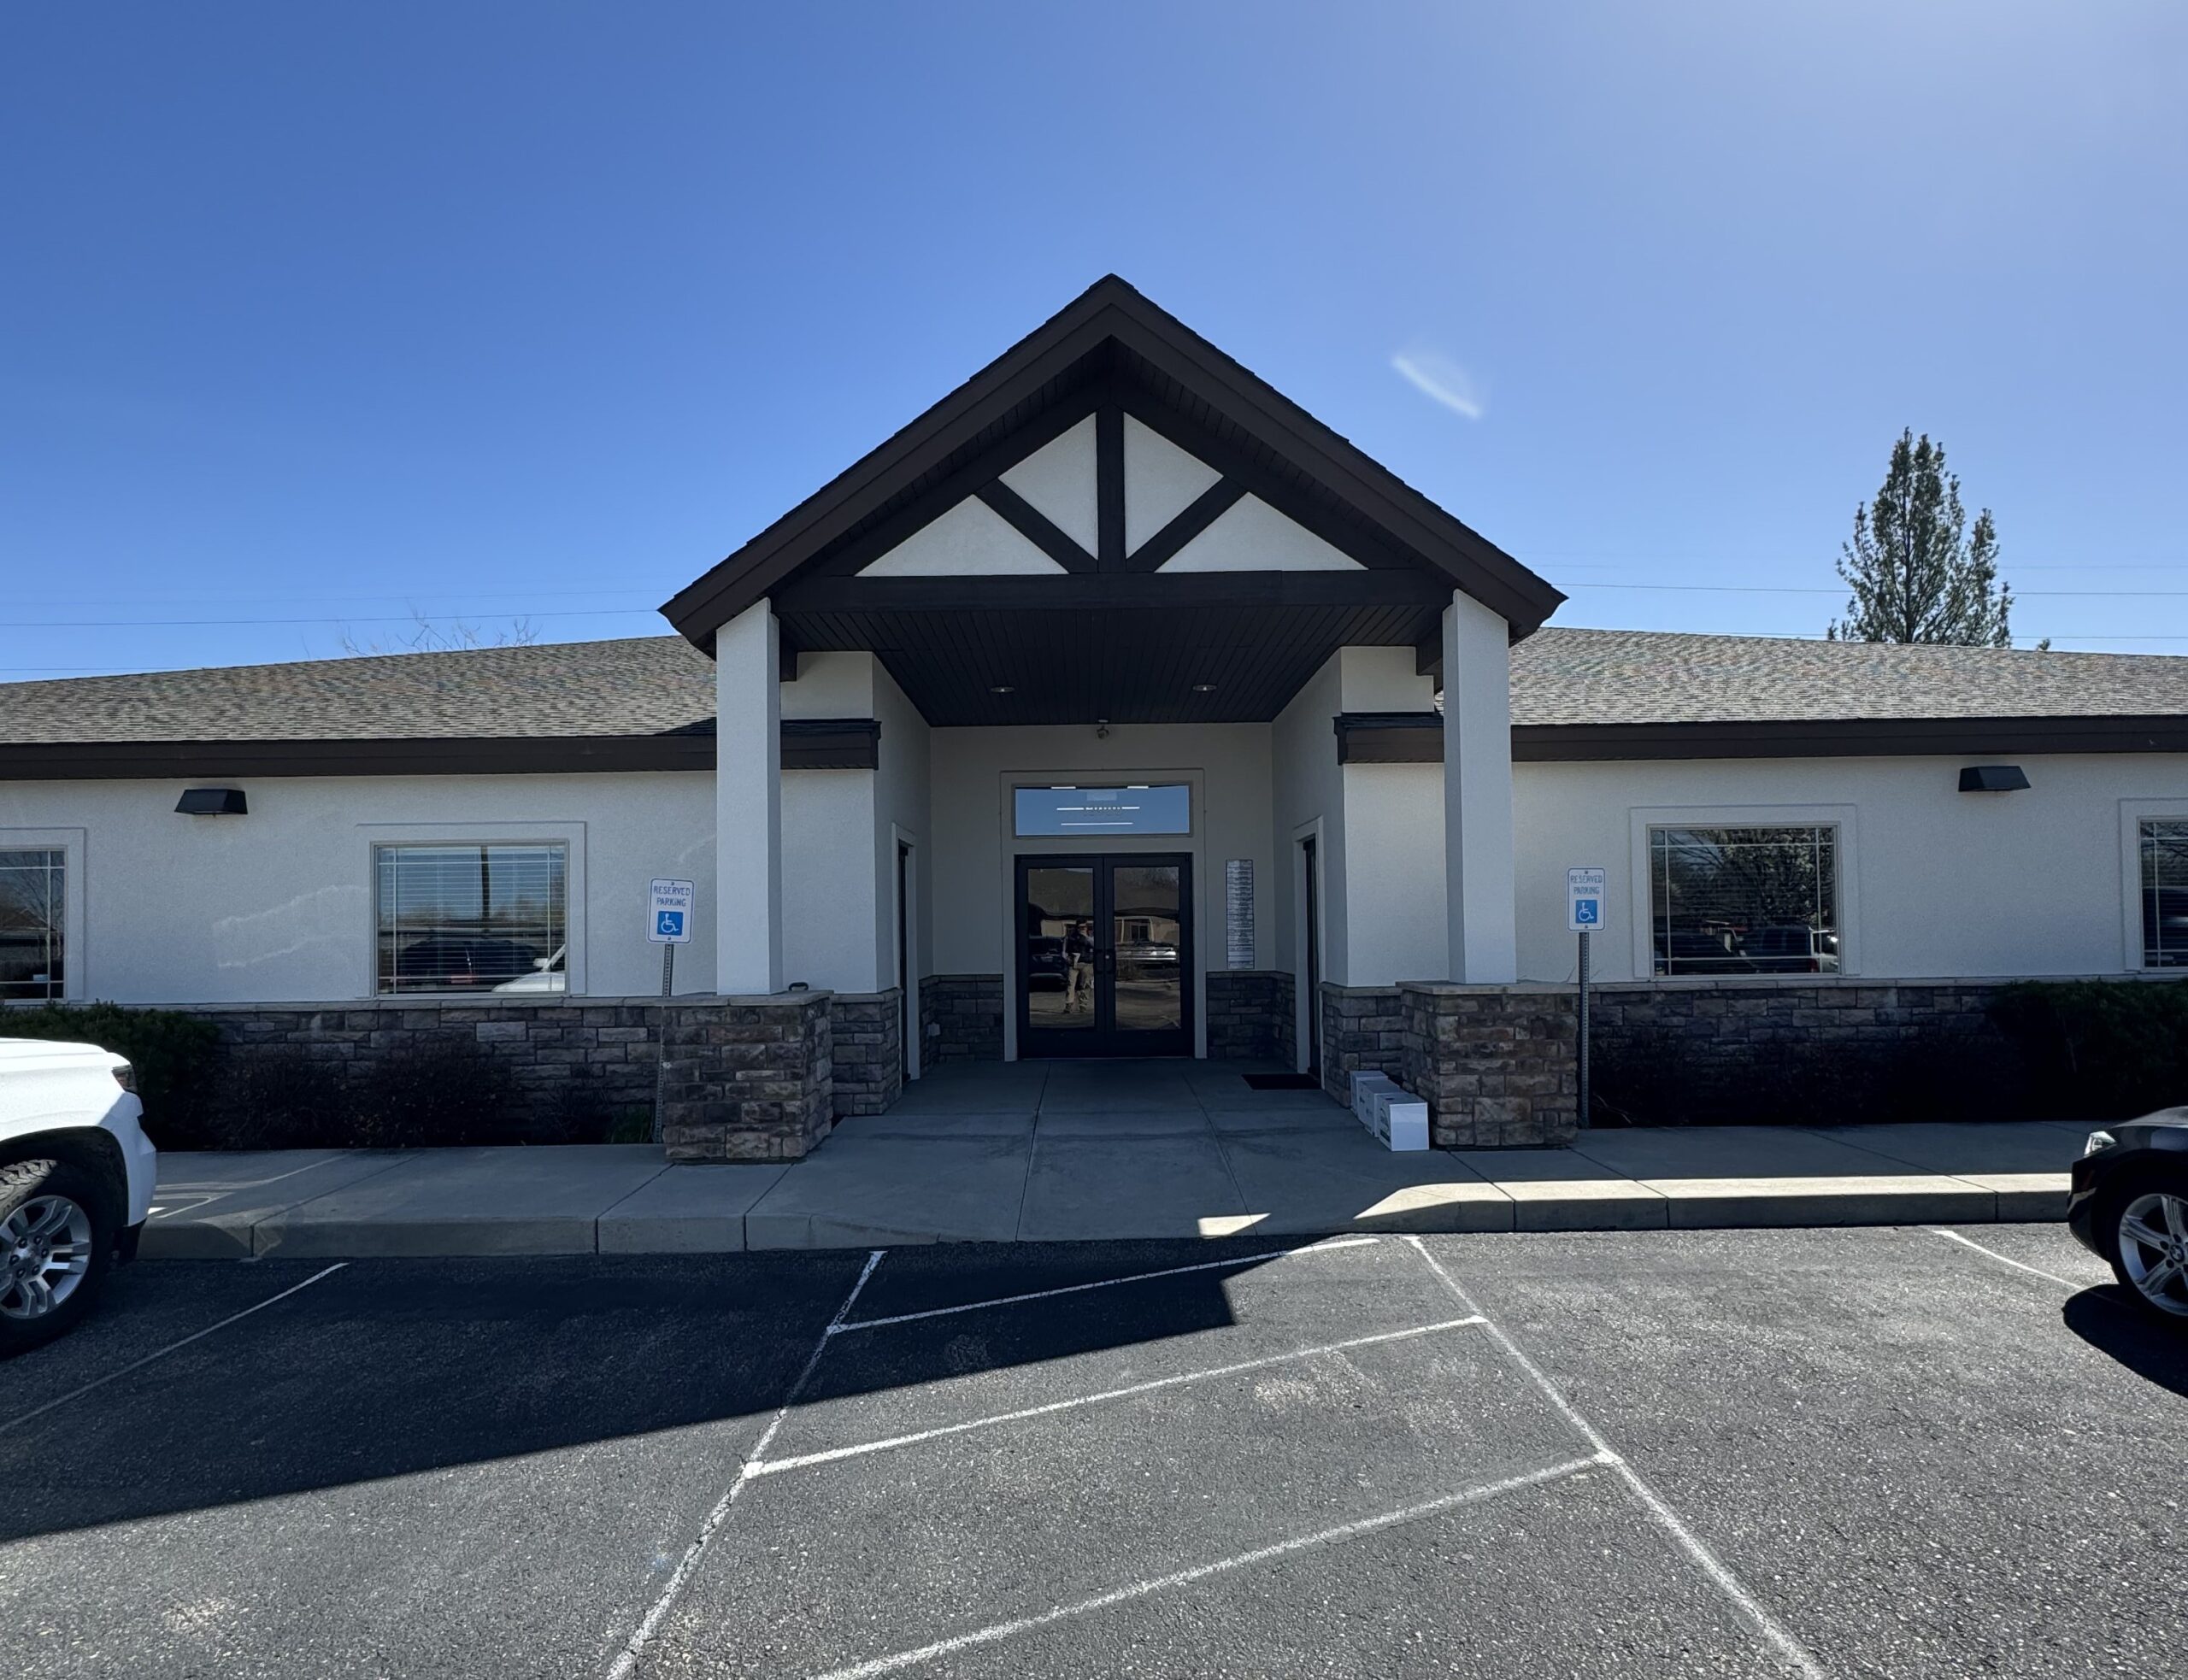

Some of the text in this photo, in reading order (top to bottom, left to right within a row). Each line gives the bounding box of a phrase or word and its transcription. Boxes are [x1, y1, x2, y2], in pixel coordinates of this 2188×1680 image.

[1570, 875, 1603, 884] RESERVED
[653, 885, 691, 896] RESERVED
[1573, 886, 1600, 895] PARKING
[656, 897, 686, 907] PARKING
